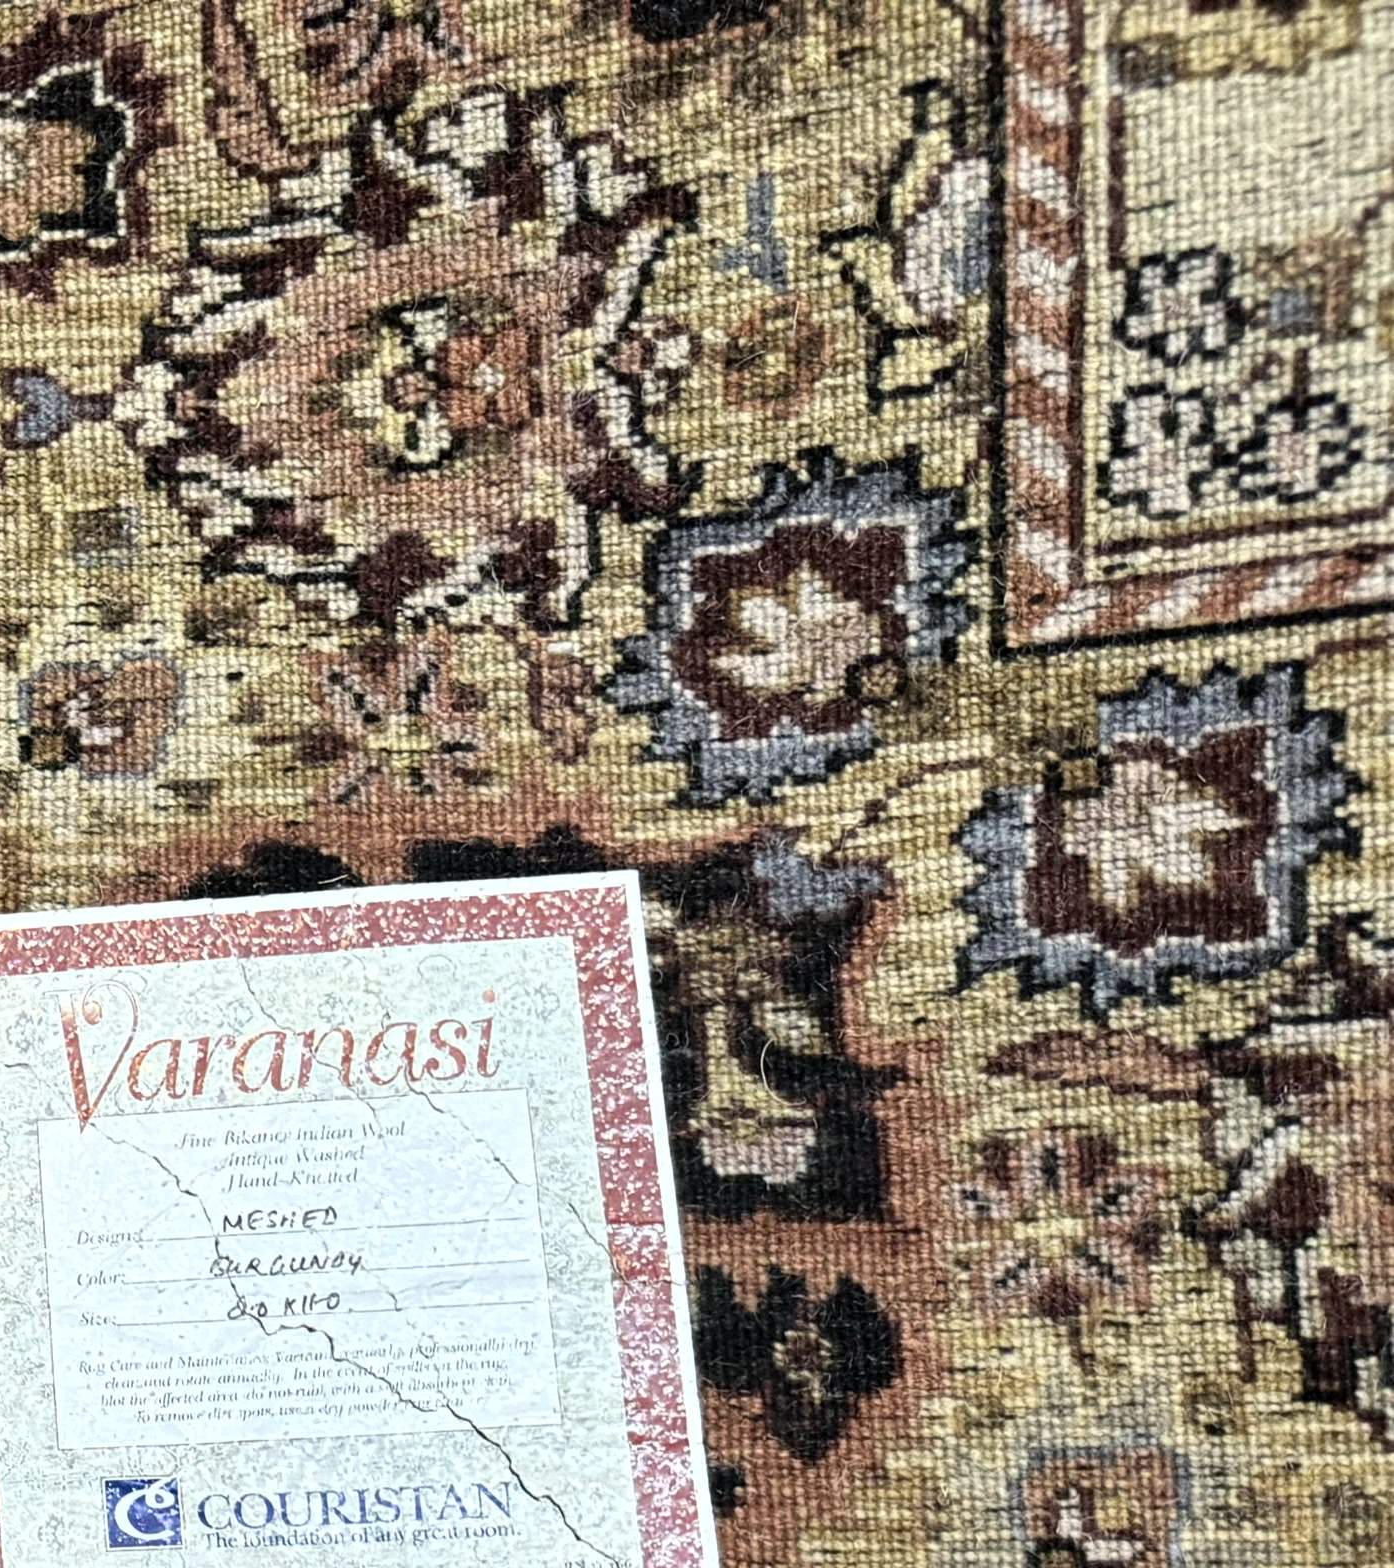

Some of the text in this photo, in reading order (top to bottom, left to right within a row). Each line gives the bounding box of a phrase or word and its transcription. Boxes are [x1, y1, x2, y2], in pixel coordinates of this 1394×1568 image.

[45, 978, 504, 1134] Varanasi
[295, 1123, 354, 1142] Indian
[362, 1120, 407, 1139] Wool
[296, 1144, 366, 1163] Washed
[293, 1367, 308, 1380] In
[312, 1366, 334, 1379] the
[196, 1480, 514, 1531] COURISTAN
[204, 1530, 238, 1550] The
[242, 1526, 346, 1549] foundation
[374, 1526, 407, 1547] any
